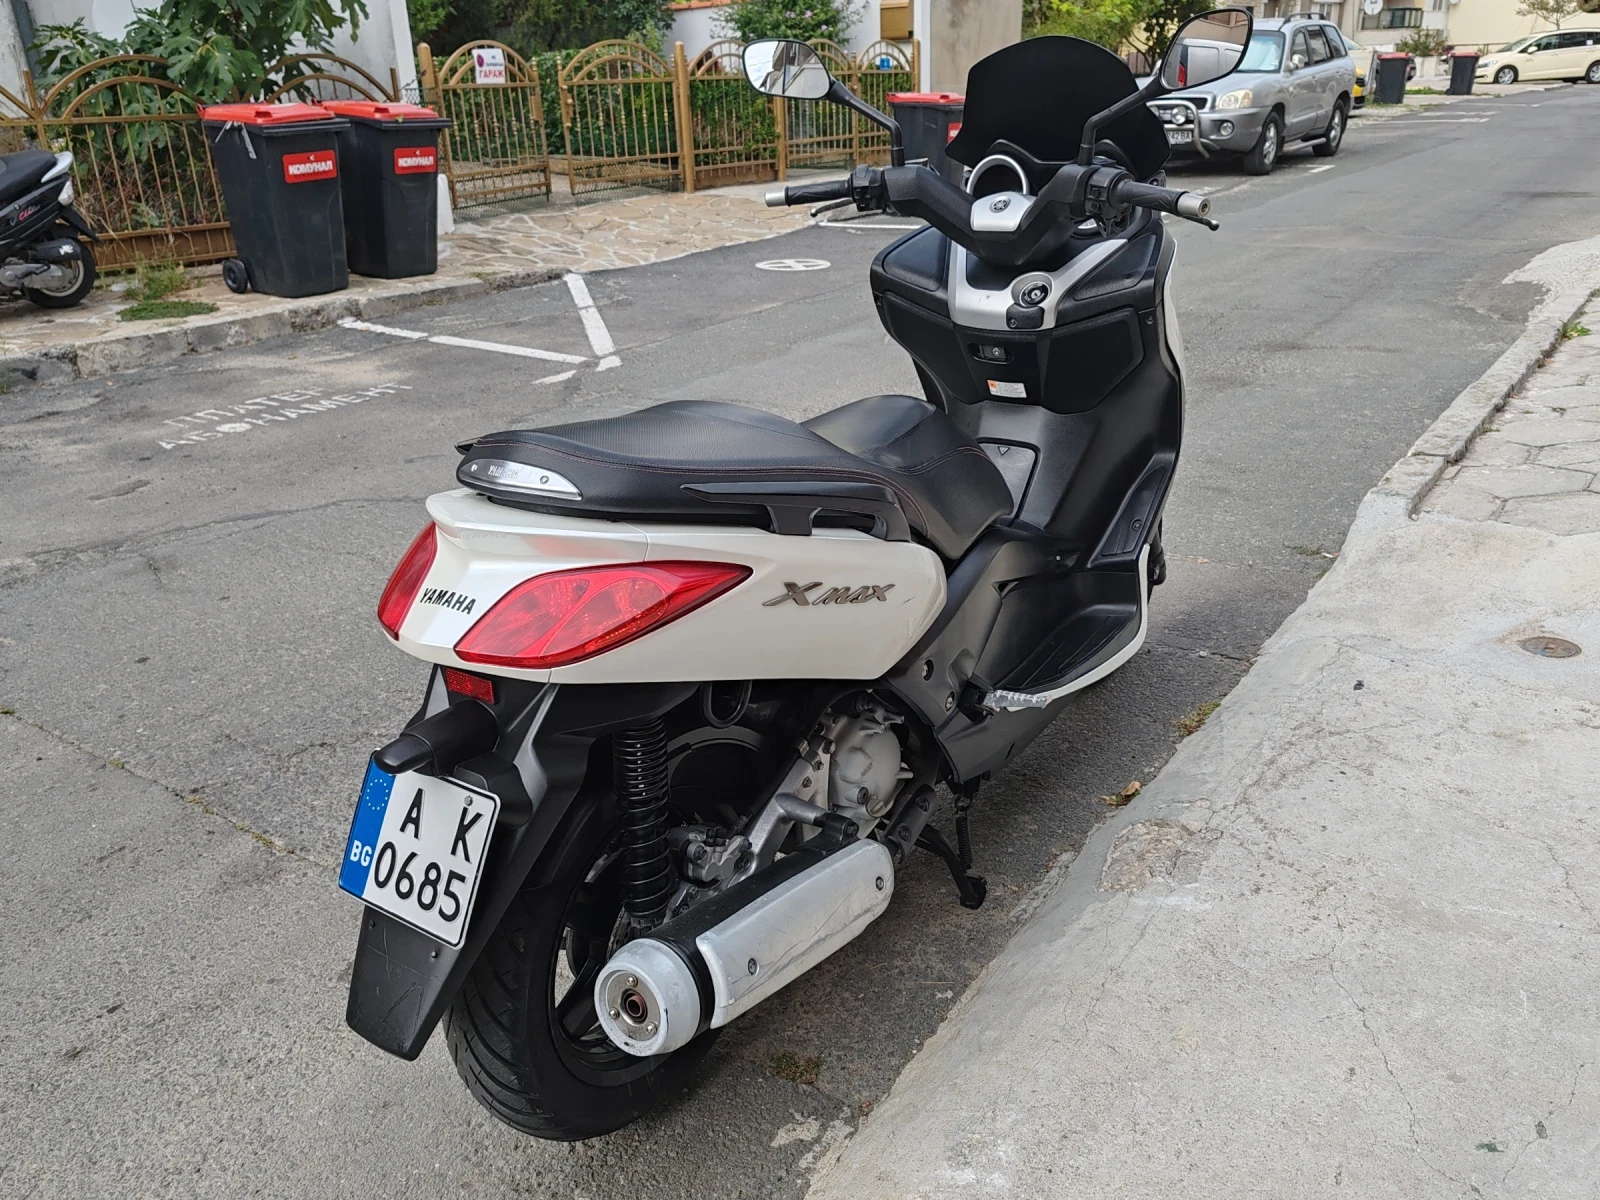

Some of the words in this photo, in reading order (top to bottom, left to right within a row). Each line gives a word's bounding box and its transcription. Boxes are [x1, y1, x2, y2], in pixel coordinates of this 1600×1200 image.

[479, 69, 504, 78] ГАРАЖ
[288, 160, 333, 175] КОМУНАЛ
[398, 156, 434, 167] КОМУНАЛ
[158, 382, 413, 450] АБОНАМЕНТ
[419, 587, 477, 615] YAMAHA
[399, 788, 425, 840] A
[450, 806, 483, 864] K
[350, 839, 372, 866] BG
[374, 841, 467, 922] 0685
